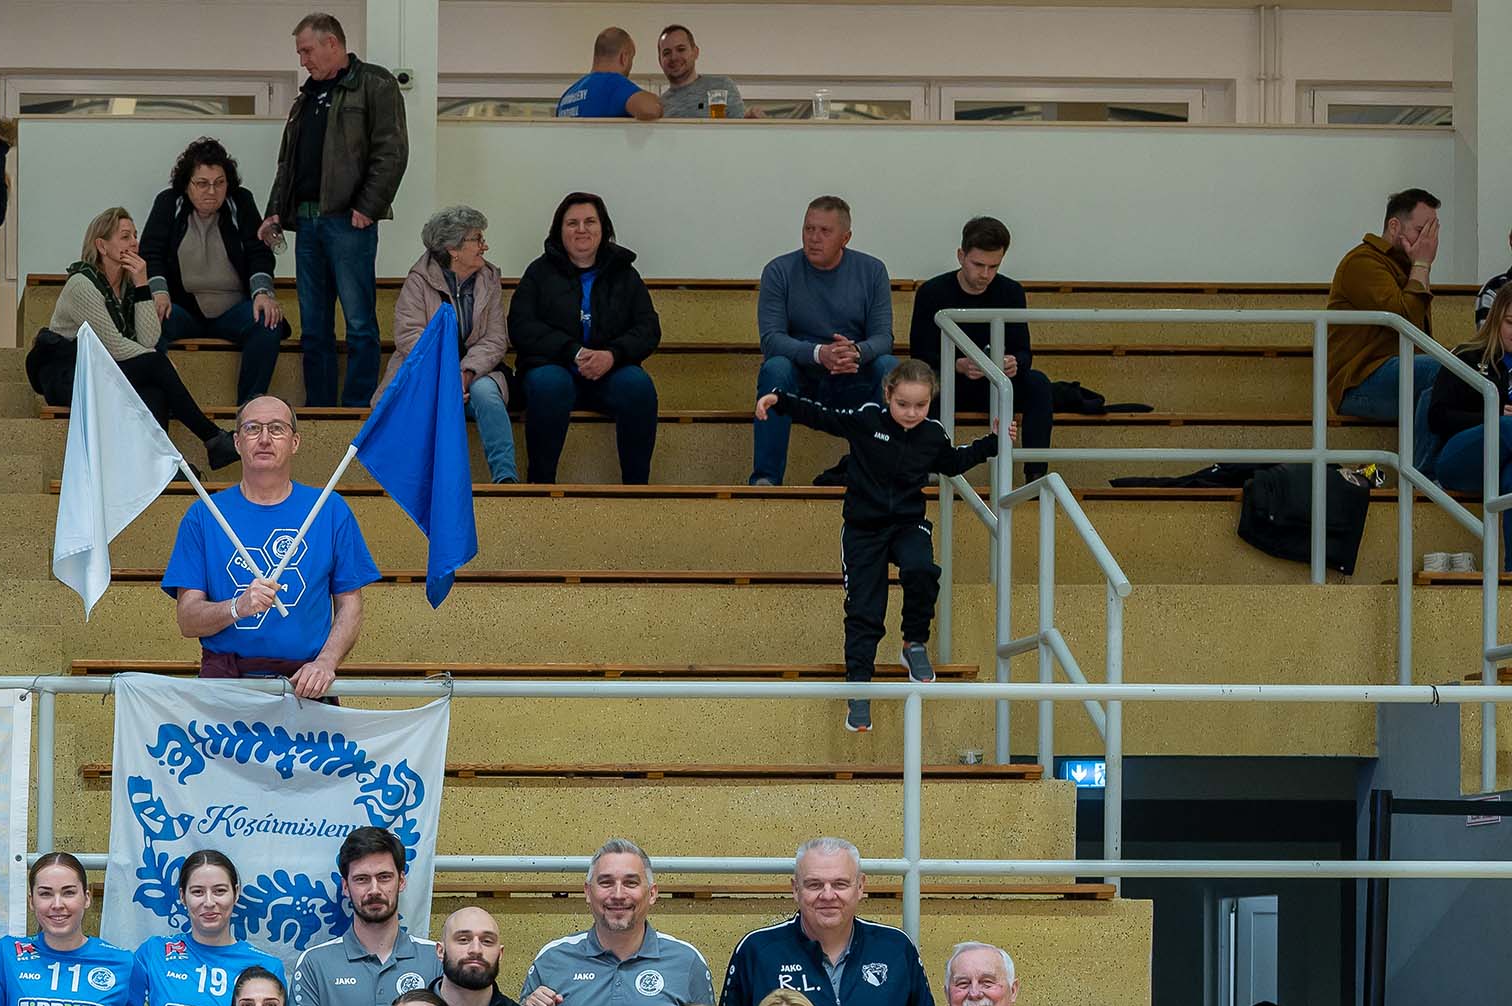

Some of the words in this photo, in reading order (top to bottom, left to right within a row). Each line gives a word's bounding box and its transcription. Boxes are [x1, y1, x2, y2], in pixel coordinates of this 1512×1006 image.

[780, 964, 803, 973] JAKO
[18, 972, 41, 980] JAKO
[47, 961, 81, 993] 11
[166, 971, 188, 981] JAKO
[195, 964, 228, 996] 19
[334, 977, 357, 985] JAKO
[572, 973, 595, 981] JAKO
[778, 973, 821, 991] R.L.
